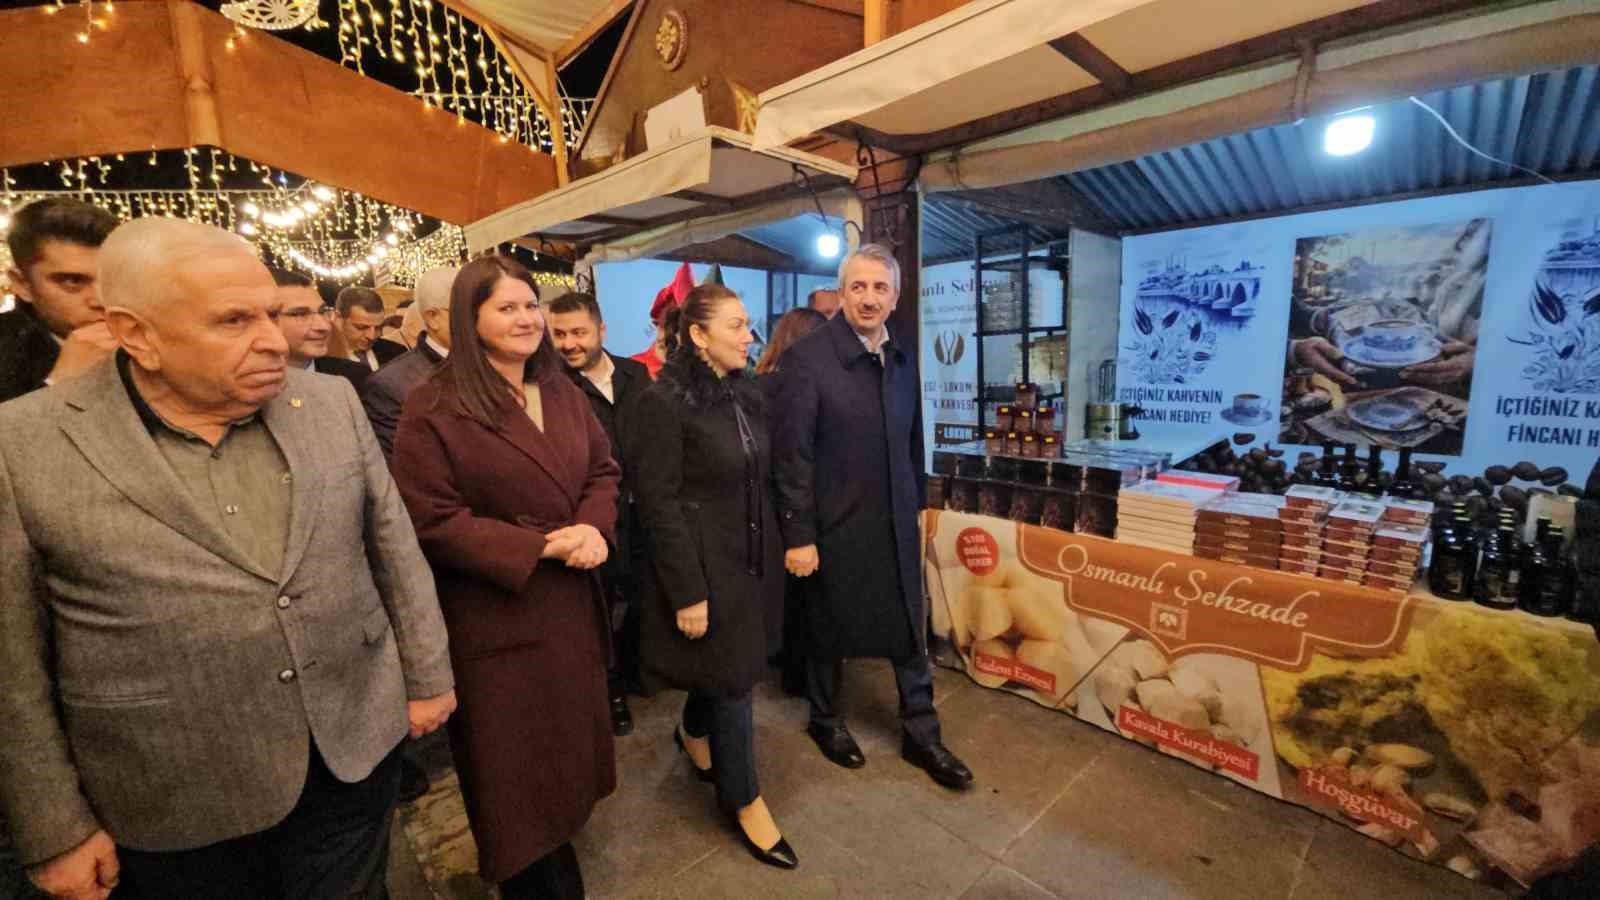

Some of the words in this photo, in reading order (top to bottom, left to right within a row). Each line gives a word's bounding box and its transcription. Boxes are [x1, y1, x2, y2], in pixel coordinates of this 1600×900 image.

[1167, 388, 1223, 404] KAHVENİN
[1496, 394, 1580, 418] İÇTİĞİNİZ
[1169, 408, 1212, 424] HEDİYE!
[1508, 423, 1581, 445] FİNCANI
[1057, 543, 1177, 594] Osmanlı
[1174, 569, 1320, 628] Şehzade
[1125, 711, 1169, 740] Kavala
[1173, 728, 1252, 771] Kurabiyesi
[1304, 768, 1419, 831] Hoşgüvar
